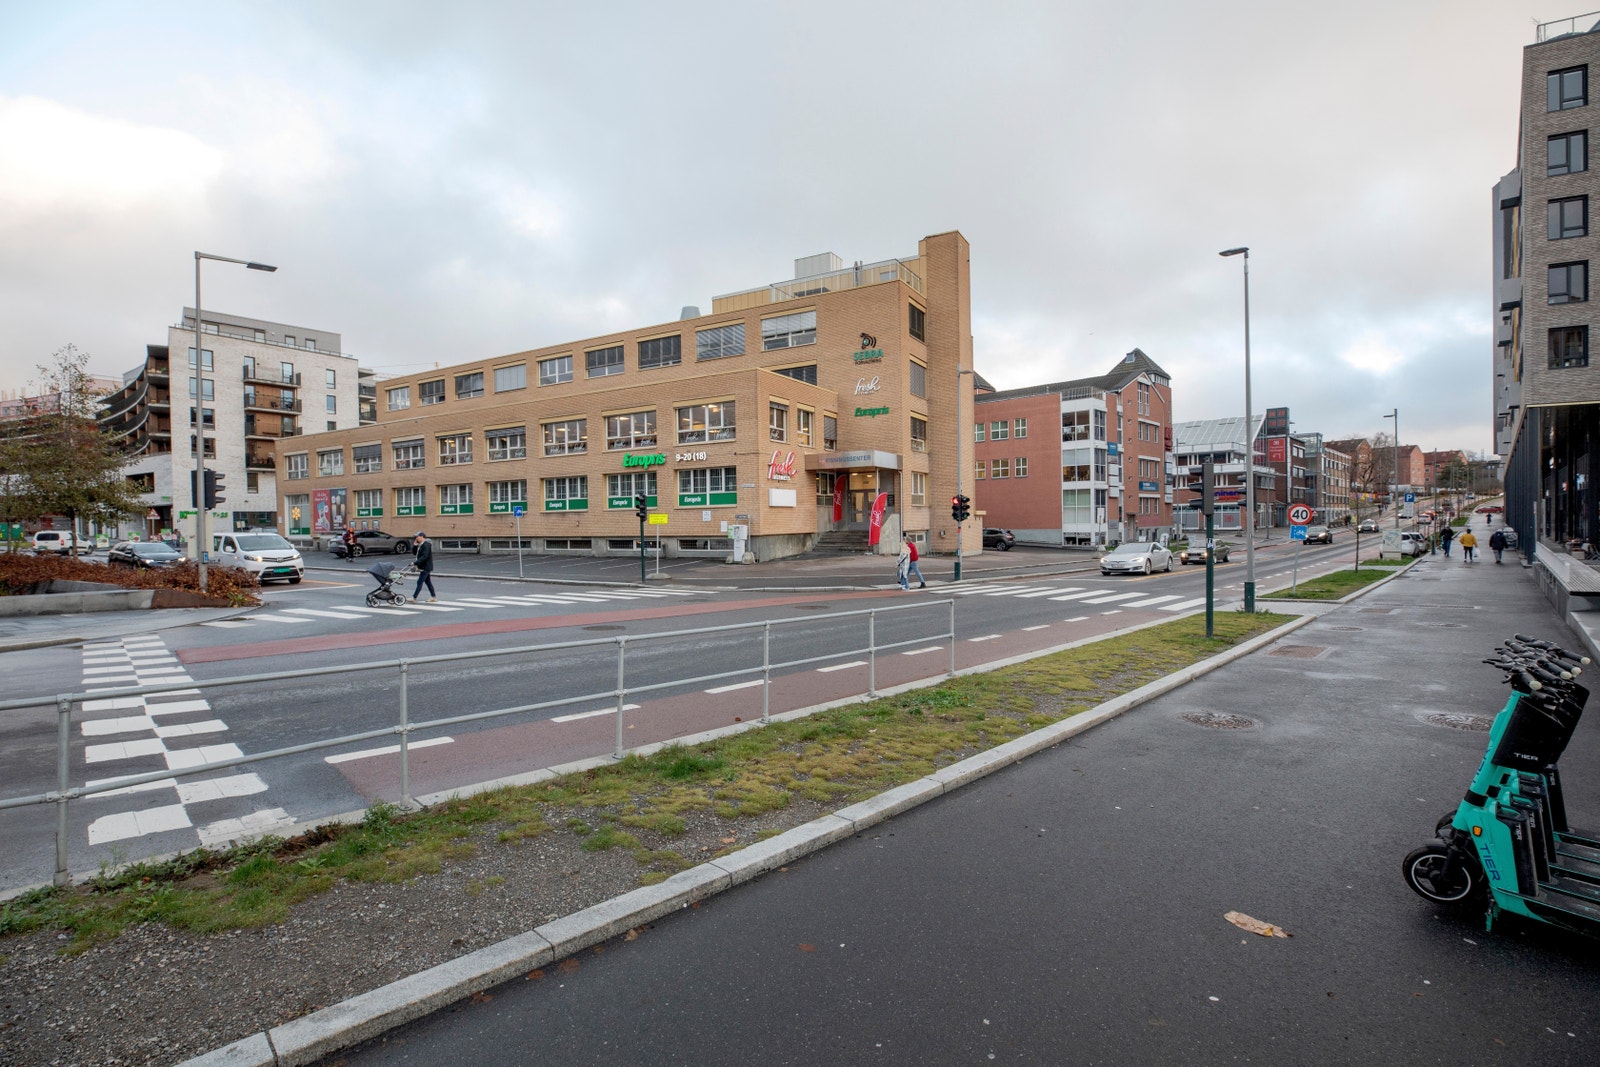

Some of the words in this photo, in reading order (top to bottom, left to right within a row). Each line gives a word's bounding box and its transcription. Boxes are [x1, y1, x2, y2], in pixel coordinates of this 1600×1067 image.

[853, 349, 884, 361] SEBRA
[854, 405, 890, 418] Europris
[622, 451, 666, 470] Europris
[675, 453, 692, 462] 9-20
[693, 451, 707, 462] (18)
[768, 450, 797, 480] fresh
[684, 496, 702, 504] Europris
[1292, 509, 1309, 520] 40
[1513, 752, 1539, 762] TIER
[1480, 843, 1500, 881] TIER
